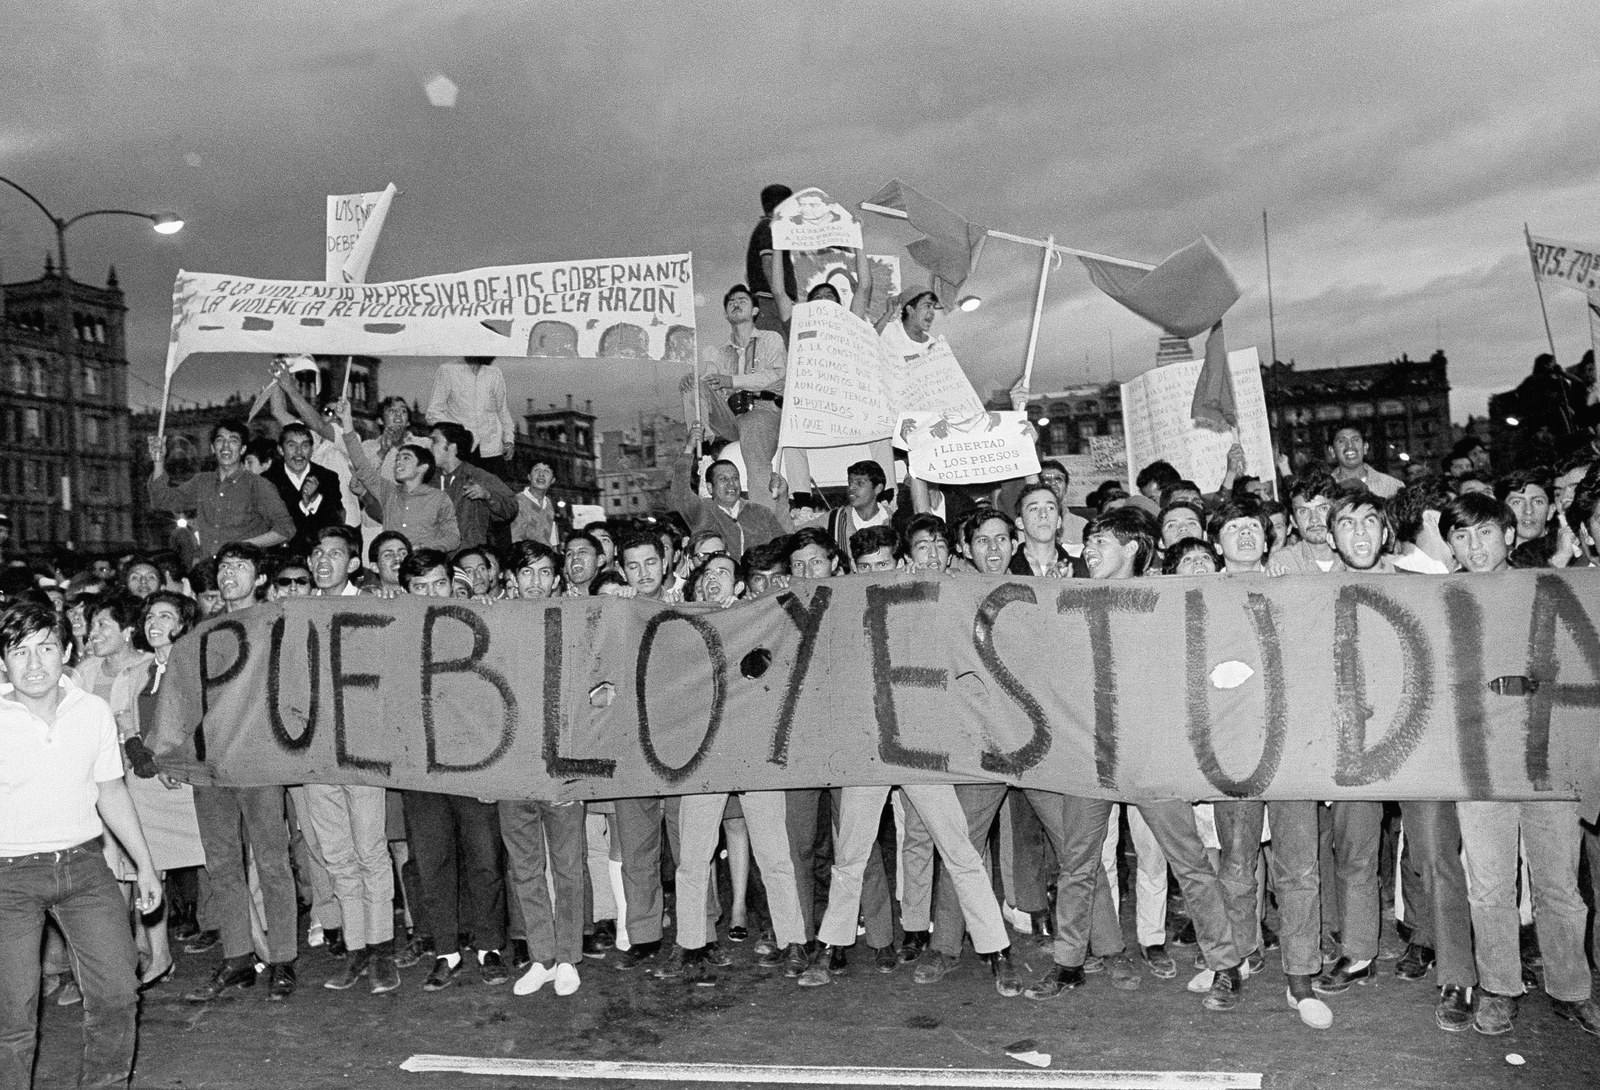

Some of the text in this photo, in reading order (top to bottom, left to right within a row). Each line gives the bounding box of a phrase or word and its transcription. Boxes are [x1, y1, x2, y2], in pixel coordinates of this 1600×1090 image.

[210, 280, 232, 293] A
[229, 281, 256, 296] LA
[200, 295, 228, 315] LA
[228, 298, 327, 316] VIOLENCIA
[524, 293, 558, 316] DE
[797, 356, 849, 374] EXIGIMOS
[794, 381, 837, 396] AUNQUE
[817, 370, 854, 388] PUNTOS
[793, 396, 855, 419] DIPUTADOS
[928, 449, 1020, 472] A LOS PRESOS
[193, 604, 729, 785] PUEBLO
[766, 584, 833, 768] Y
